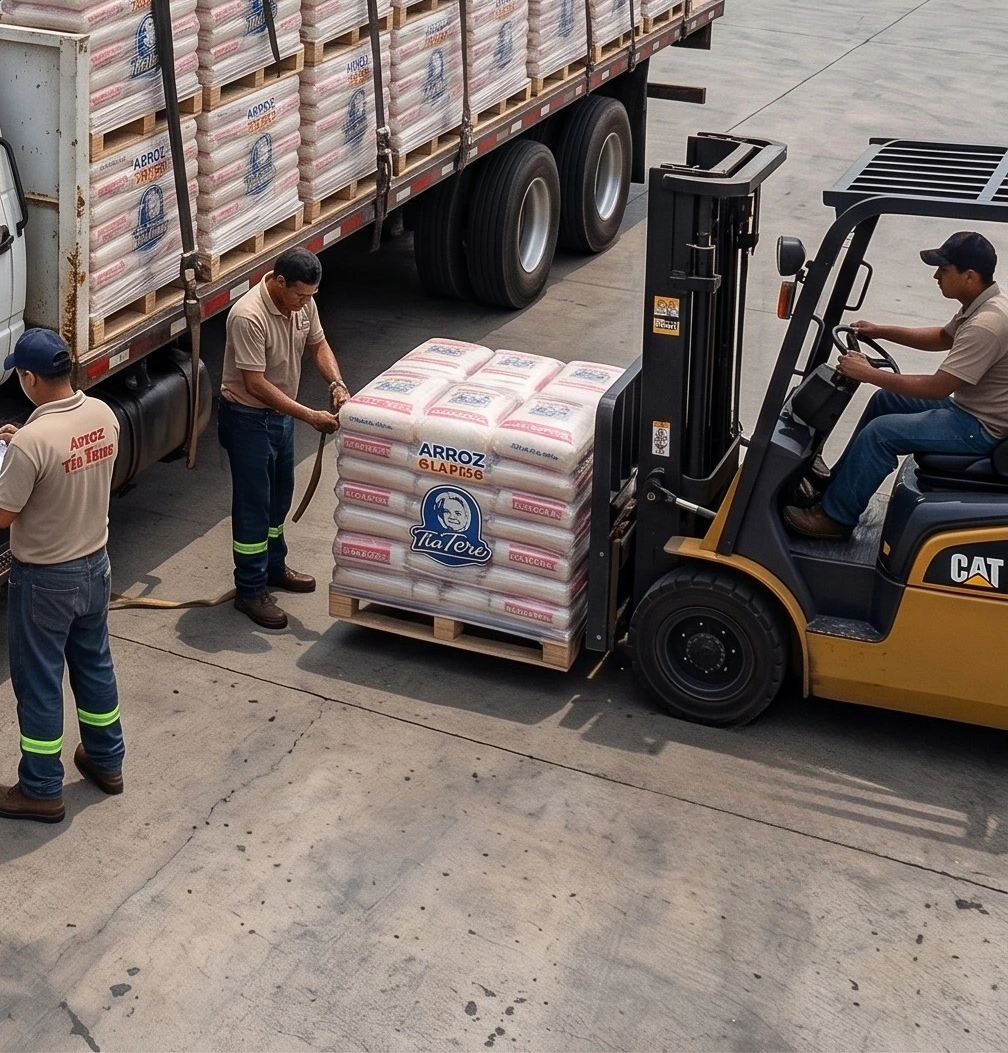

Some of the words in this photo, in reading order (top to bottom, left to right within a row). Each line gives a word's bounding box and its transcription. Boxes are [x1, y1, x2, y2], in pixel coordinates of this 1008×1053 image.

[418, 443, 485, 468] ARROZ
[438, 531, 490, 558] Tere
[950, 553, 1004, 588] CAT
